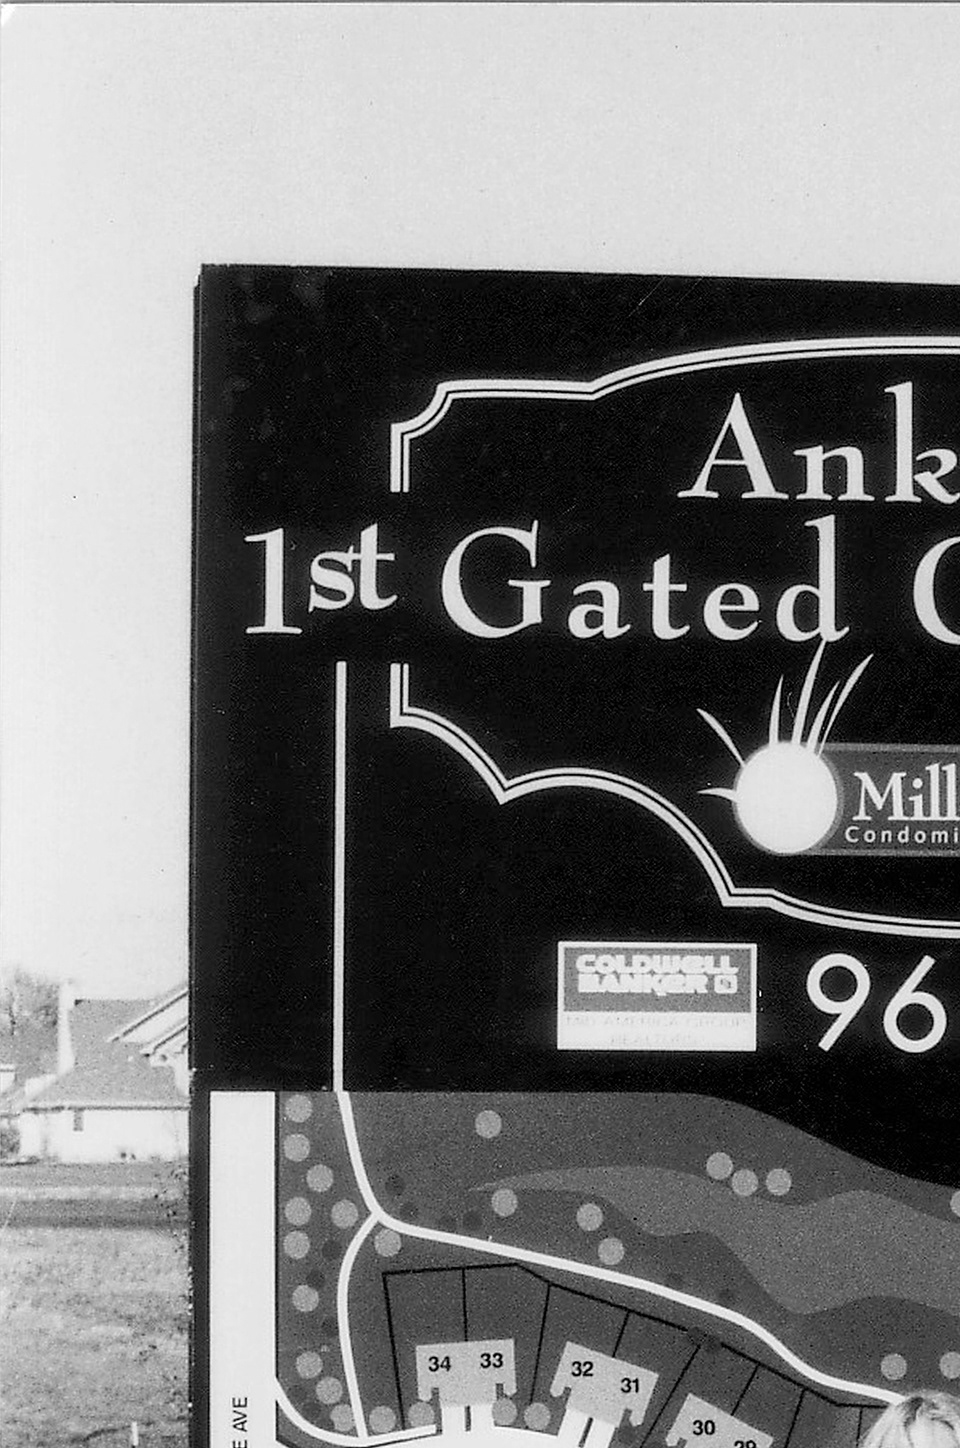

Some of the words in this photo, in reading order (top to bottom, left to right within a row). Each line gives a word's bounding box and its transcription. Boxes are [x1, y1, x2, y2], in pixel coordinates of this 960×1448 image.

[244, 523, 398, 634] 1st
[441, 514, 850, 643] Gated
[575, 954, 739, 975] COLDWELL
[428, 1355, 452, 1373] 34
[480, 1352, 504, 1369] 33
[571, 1360, 594, 1377] 32
[620, 1377, 640, 1394] 31
[232, 1397, 248, 1432] AVE
[692, 1419, 716, 1436] 30
